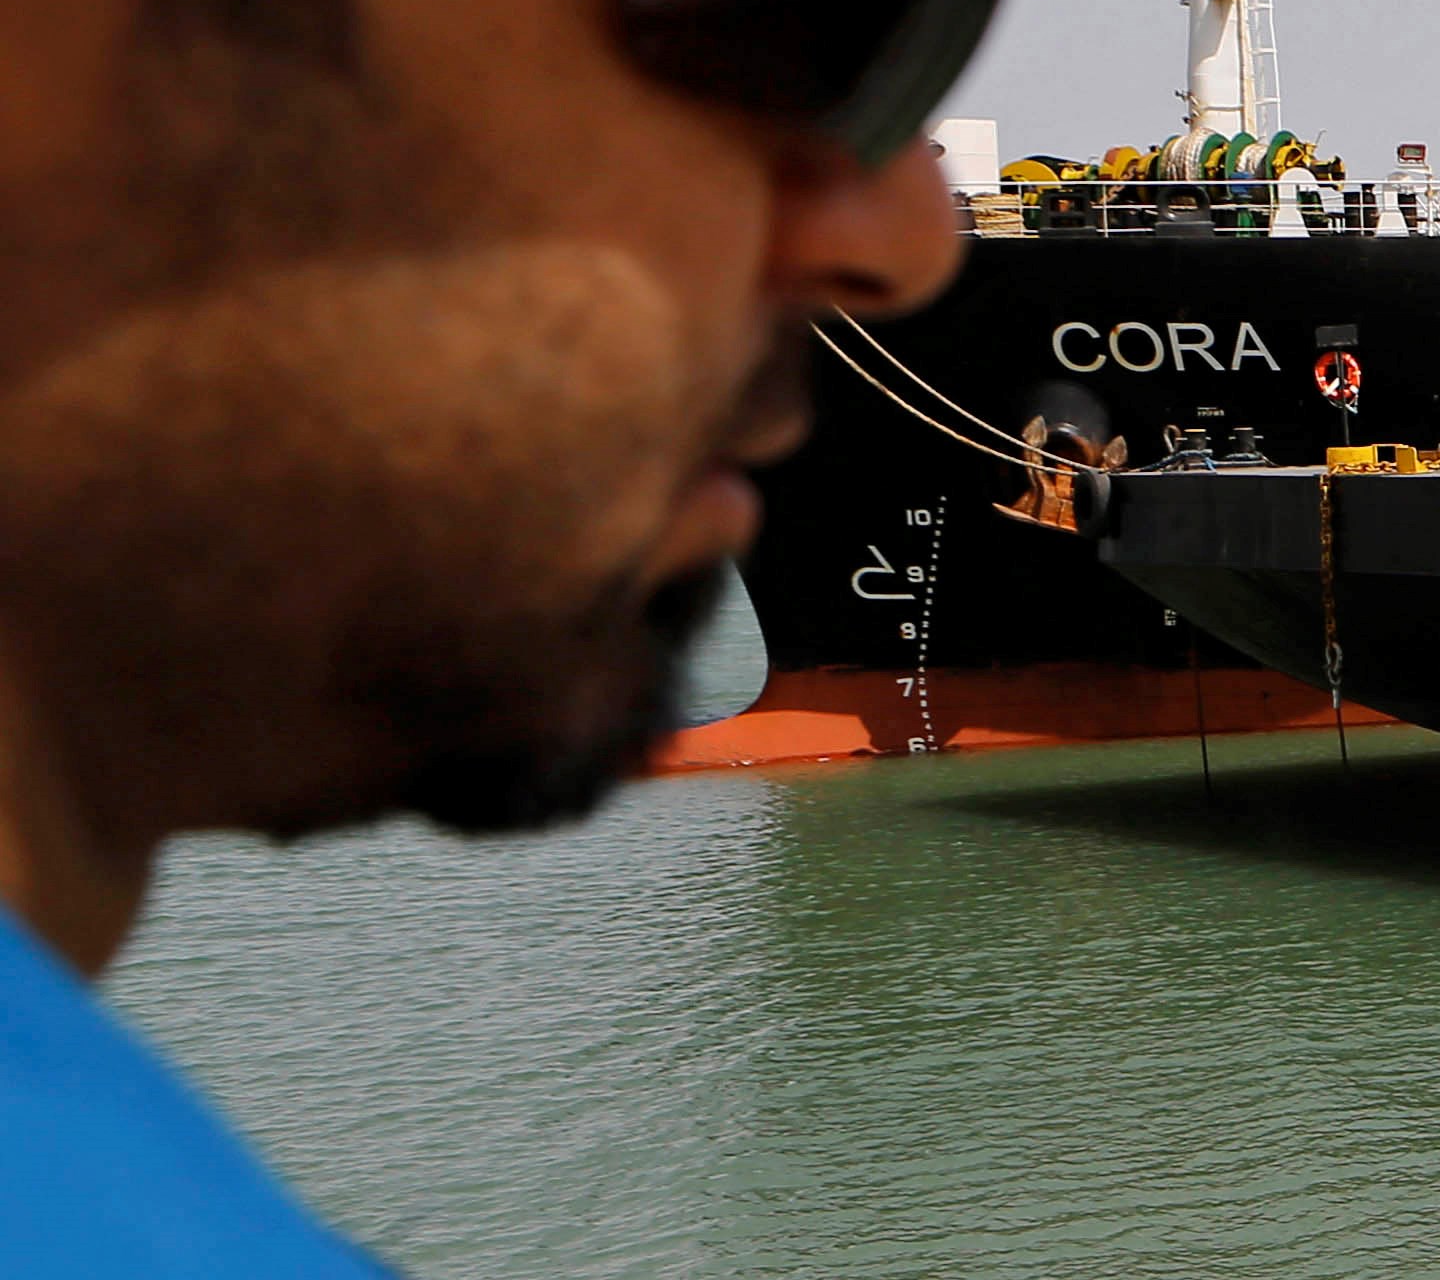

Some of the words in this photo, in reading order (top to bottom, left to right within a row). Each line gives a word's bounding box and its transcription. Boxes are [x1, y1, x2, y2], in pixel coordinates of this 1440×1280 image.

[1052, 321, 1281, 372] CORA
[906, 509, 931, 526] 10
[906, 566, 925, 583] 9
[900, 622, 917, 639] 8
[896, 677, 914, 697] 7
